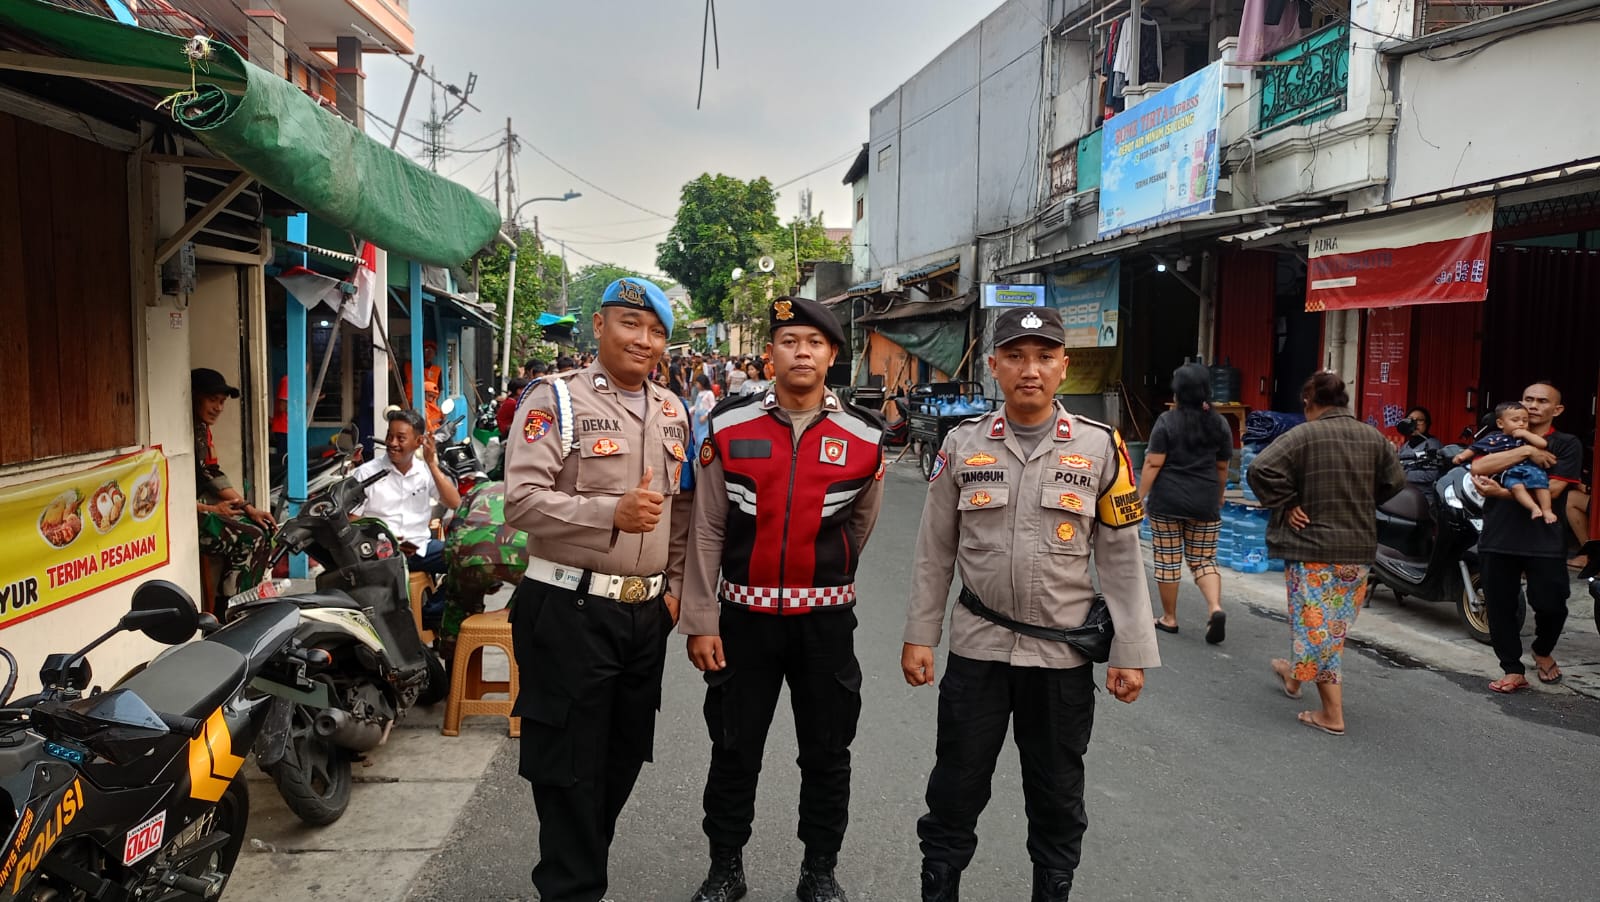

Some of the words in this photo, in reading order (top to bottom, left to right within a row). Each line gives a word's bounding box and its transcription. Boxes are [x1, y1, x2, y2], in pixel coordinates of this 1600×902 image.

[1314, 237, 1338, 253] AURA
[582, 418, 621, 433] DEKA.K
[663, 426, 683, 439] POLRI
[961, 471, 1004, 483] TANGGUH
[1055, 471, 1091, 487] POLRI
[46, 553, 98, 589] TERIMA
[101, 534, 156, 571] PESANAN
[12, 778, 84, 896] POLISI
[127, 823, 162, 858] 110
